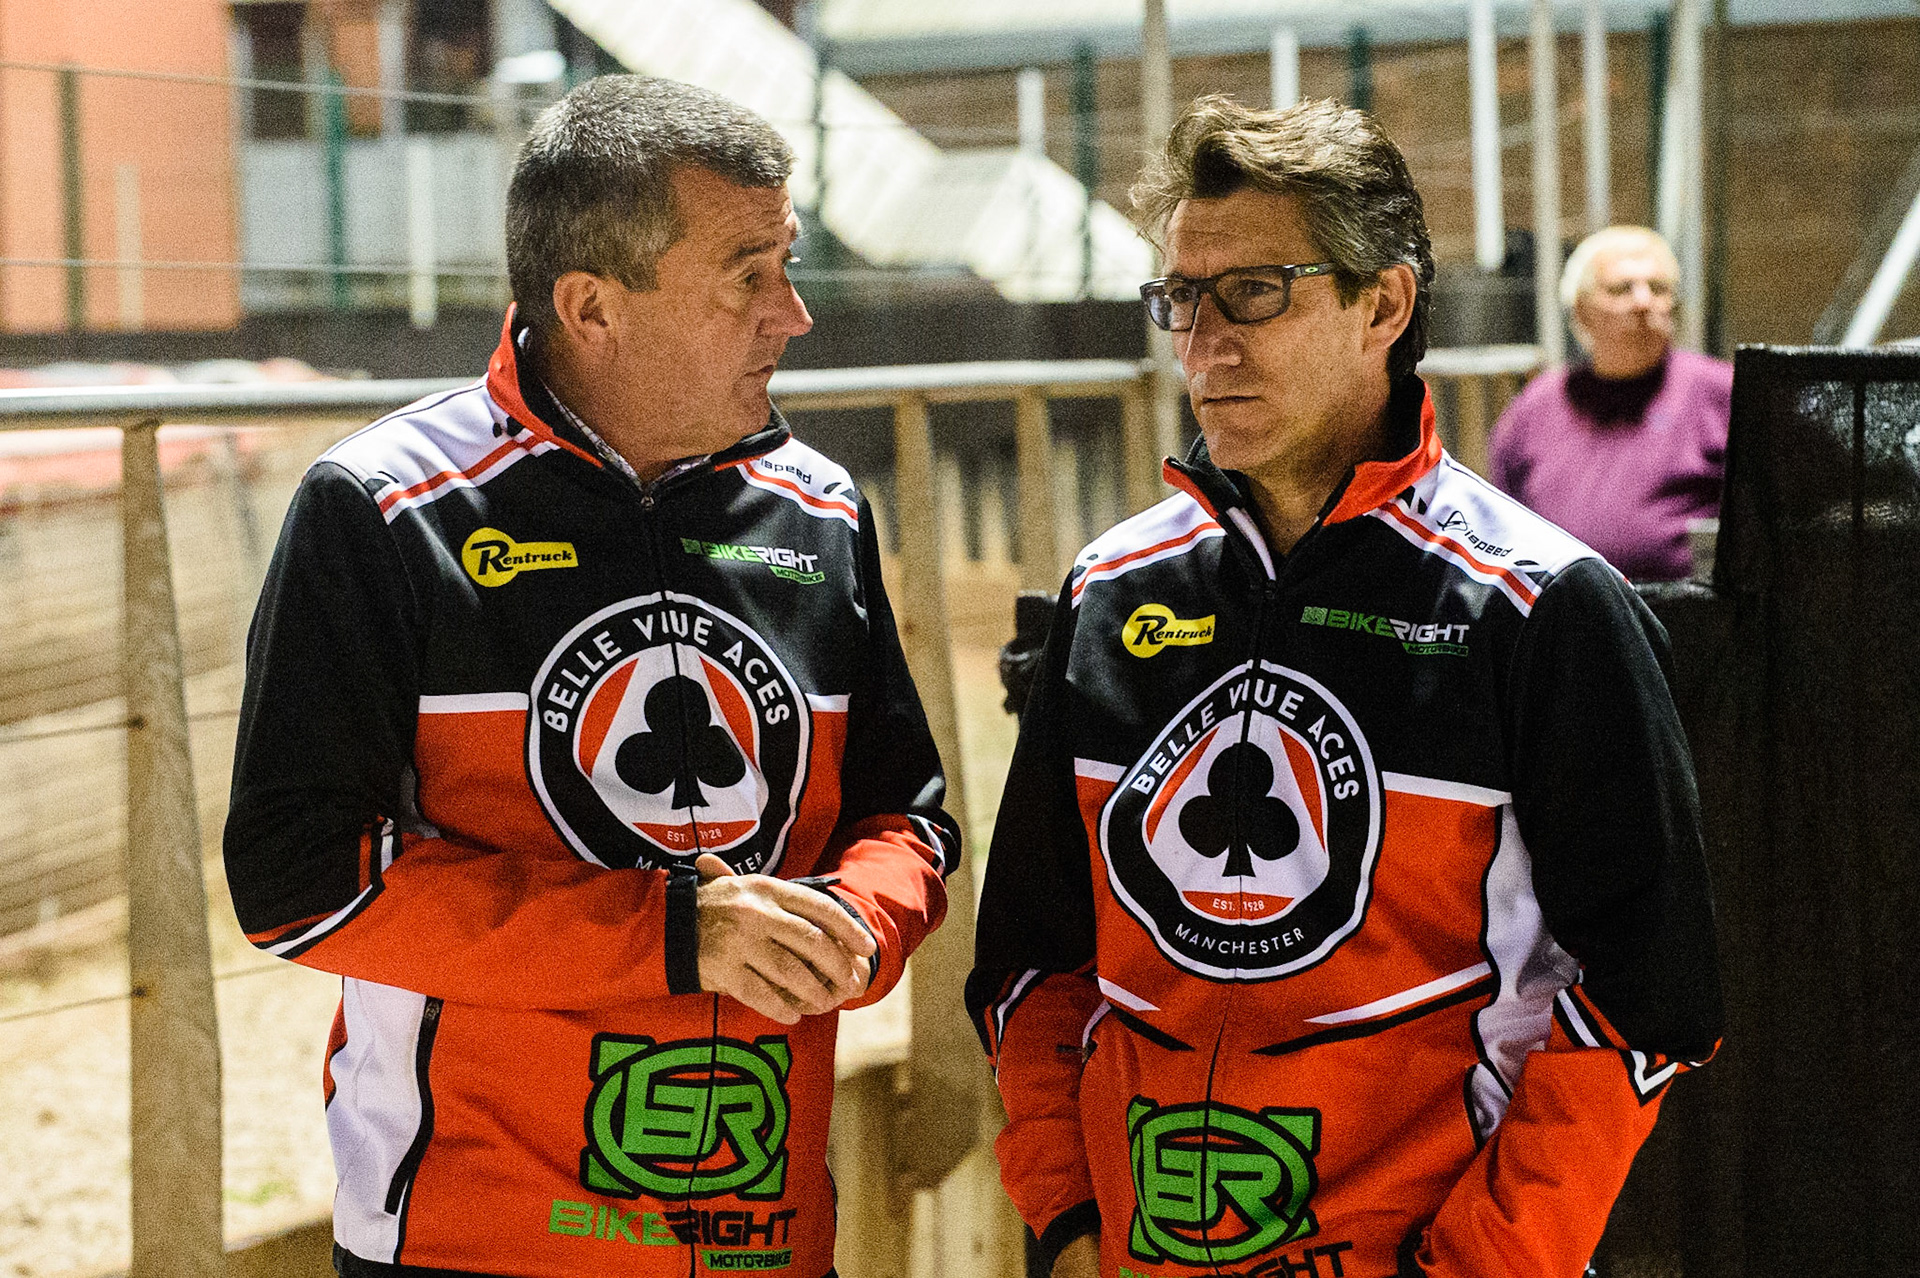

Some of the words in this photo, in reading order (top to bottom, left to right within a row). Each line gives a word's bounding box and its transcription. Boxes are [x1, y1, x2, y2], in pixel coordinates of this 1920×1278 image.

[470, 540, 573, 575] Rentruck
[1132, 615, 1213, 646] Rentruck
[1326, 608, 1470, 643] BIKERIGHT
[543, 631, 622, 732] BELLE
[722, 641, 790, 725] ACES
[1131, 702, 1216, 795] BELLE
[1308, 715, 1360, 800] ACES
[1212, 898, 1236, 911] EST.
[1175, 923, 1305, 955] MANCHESTER
[549, 1199, 798, 1247] BIKERIGHT
[708, 1250, 792, 1269] MOTORBIKE
